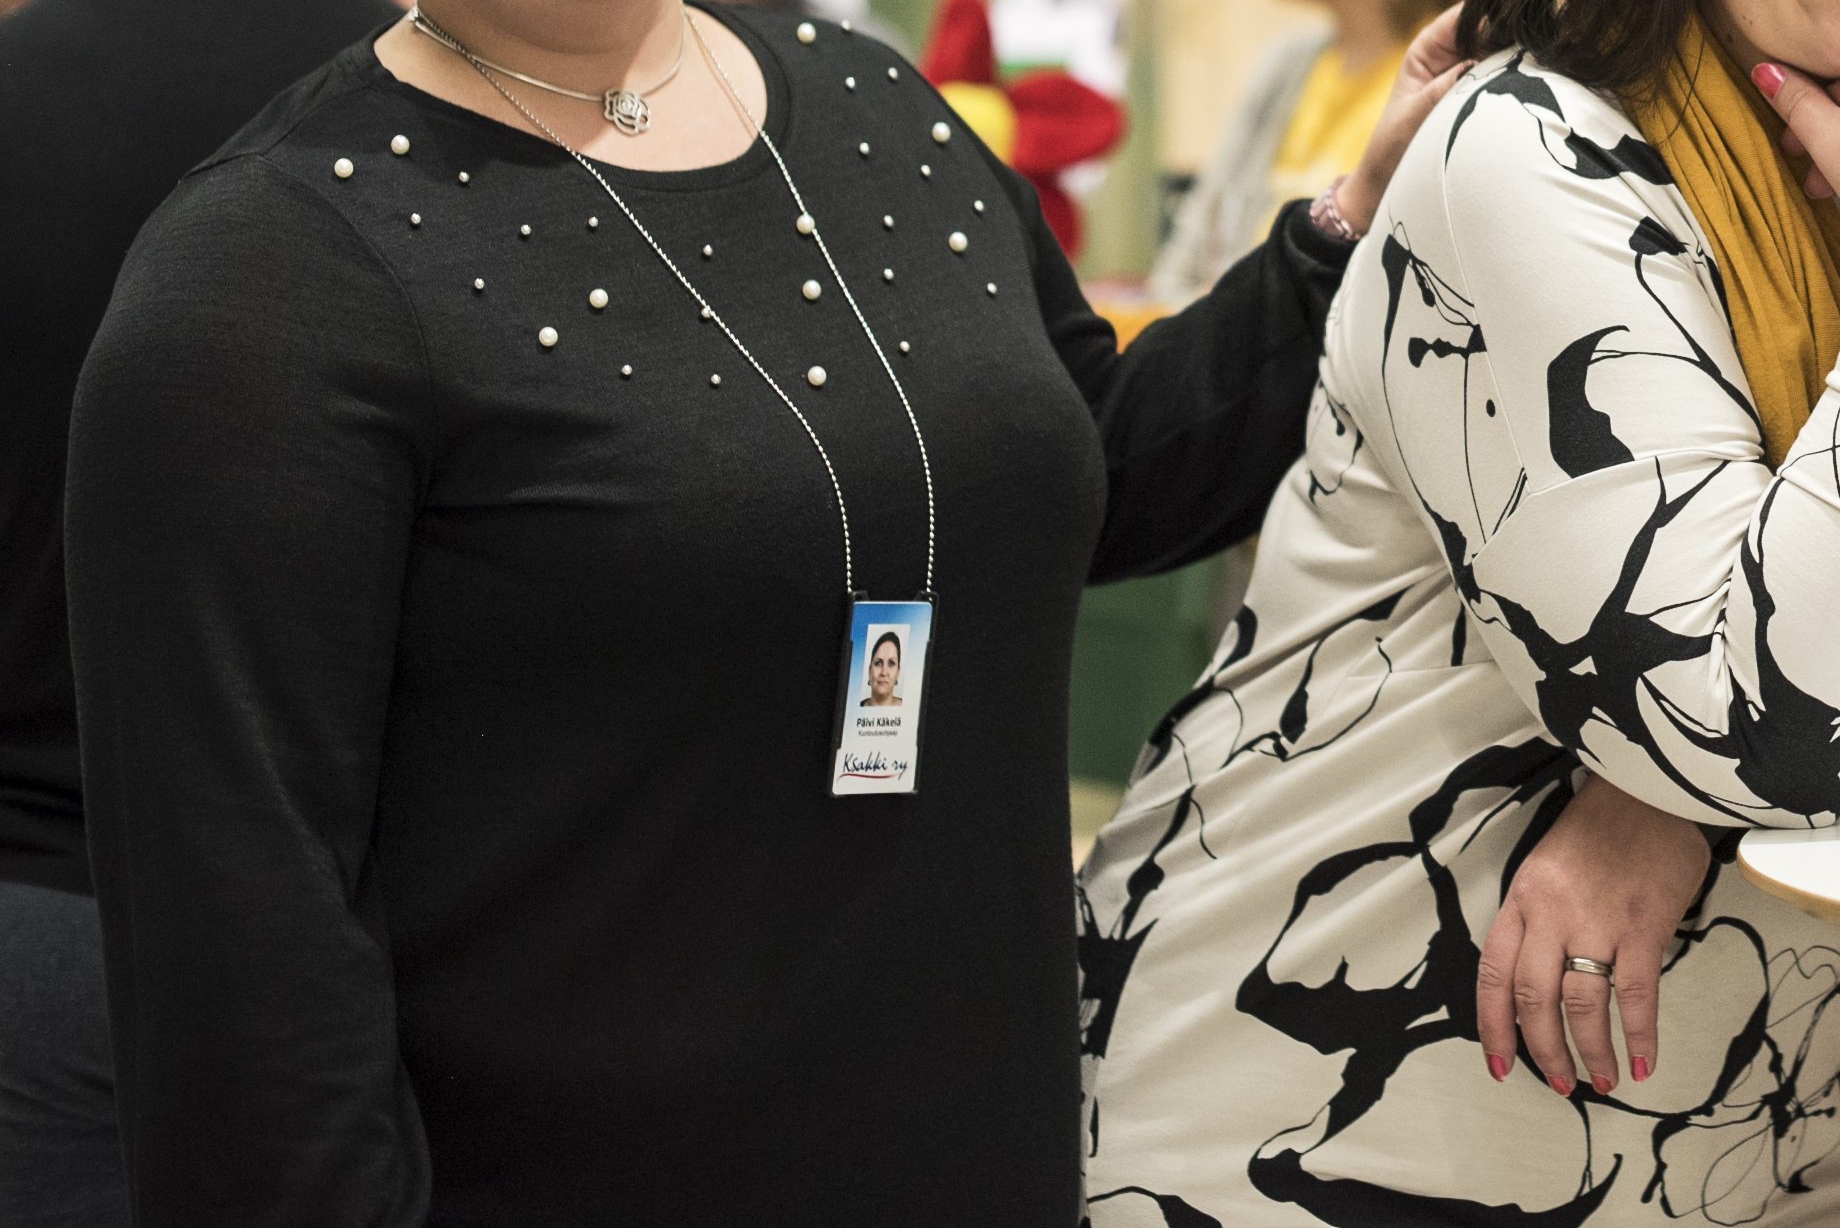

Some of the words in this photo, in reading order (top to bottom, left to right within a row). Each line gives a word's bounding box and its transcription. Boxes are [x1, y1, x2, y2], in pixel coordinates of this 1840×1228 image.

[857, 716, 875, 728] Päivi
[876, 716, 902, 728] Käkelä
[843, 751, 887, 773] Ksakki
[891, 760, 908, 780] ry
